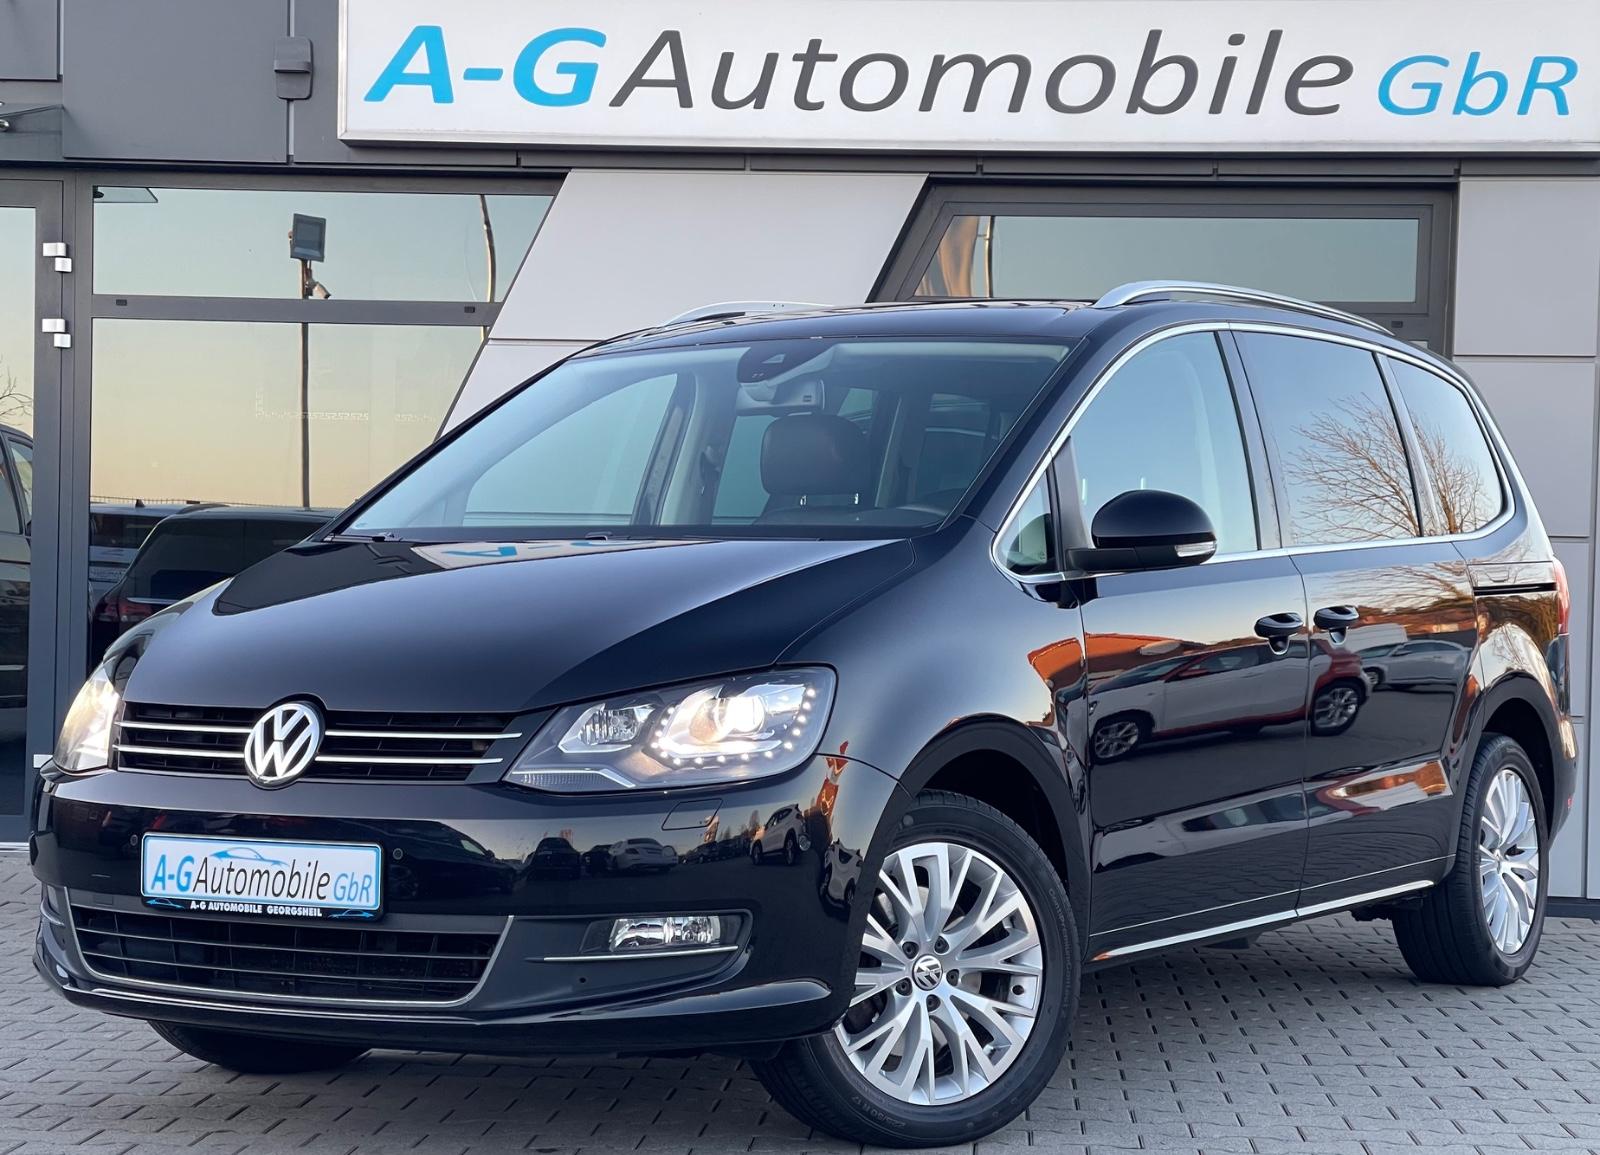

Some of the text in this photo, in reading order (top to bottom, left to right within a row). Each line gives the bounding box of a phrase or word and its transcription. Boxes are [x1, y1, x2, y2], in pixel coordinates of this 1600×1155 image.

[364, 26, 1577, 116] A-G Automobile GbR
[151, 854, 373, 903] A-G Automobile GbR
[190, 901, 323, 917] A-G AUTOMOBILE GEORGSHEIL
